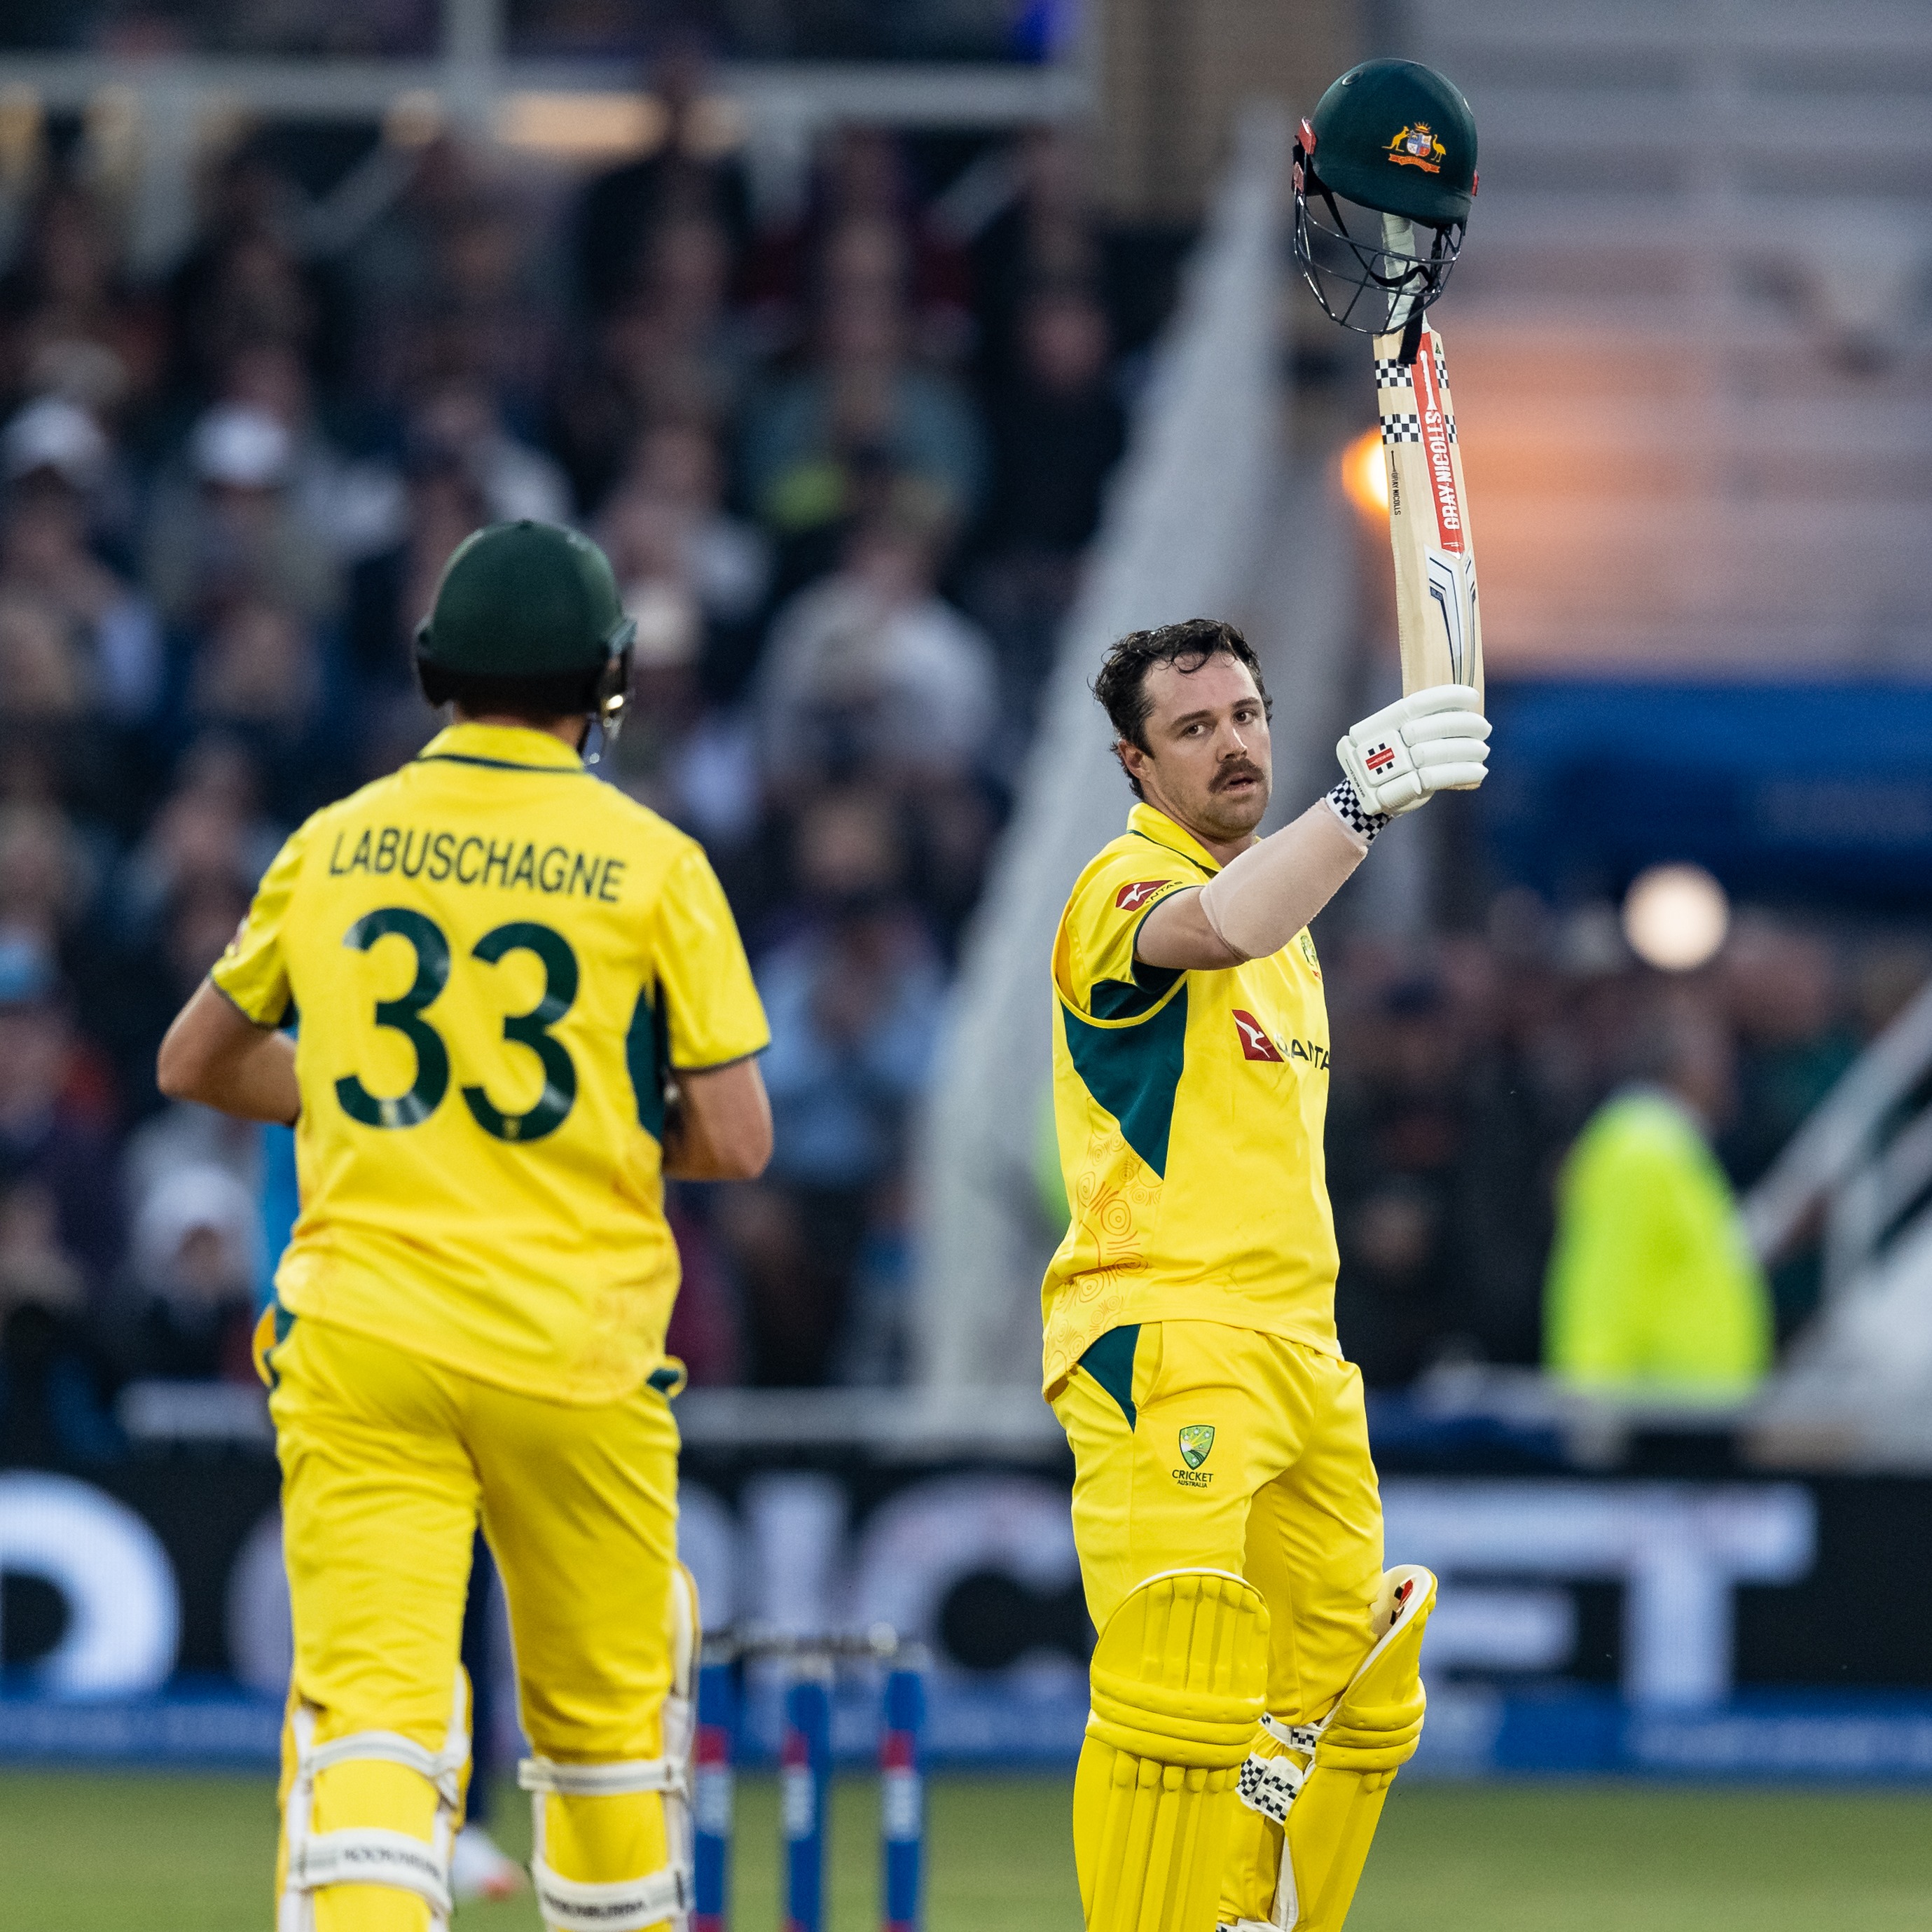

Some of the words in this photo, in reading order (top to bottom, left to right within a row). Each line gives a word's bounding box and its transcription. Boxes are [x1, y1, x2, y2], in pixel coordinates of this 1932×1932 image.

[1393, 489, 1402, 516] NICOLLS
[329, 827, 627, 902] LABUSCHAGNE
[333, 904, 580, 1145] 33
[1172, 1469, 1214, 1482] CRICKET
[1178, 1479, 1208, 1488] AUSTRALIA
